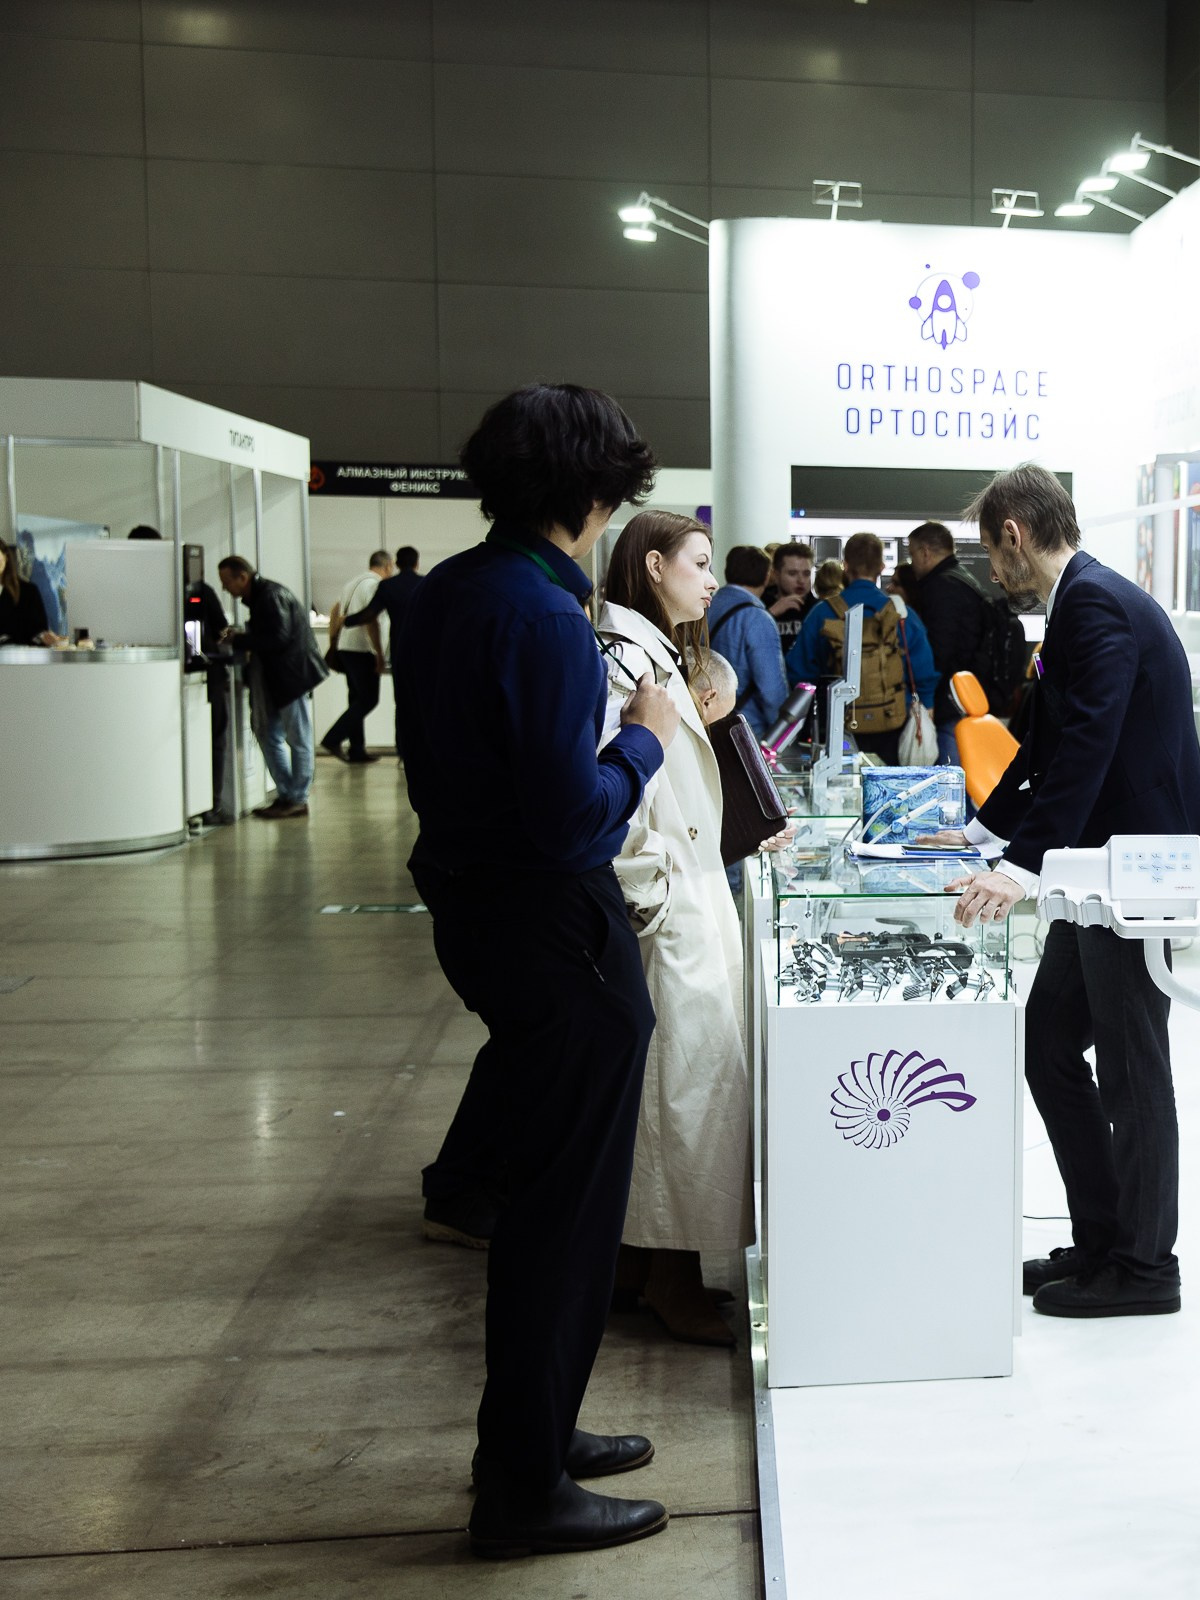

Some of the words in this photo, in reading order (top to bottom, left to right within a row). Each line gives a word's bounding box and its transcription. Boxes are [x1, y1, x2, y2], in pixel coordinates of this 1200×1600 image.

[837, 363, 1048, 397] ORTHOSPACE
[846, 407, 1039, 440] ОРТОСПЭЙС
[336, 465, 408, 479] АЛМАЗНЫЙ
[389, 480, 441, 493] ФЕНИКС
